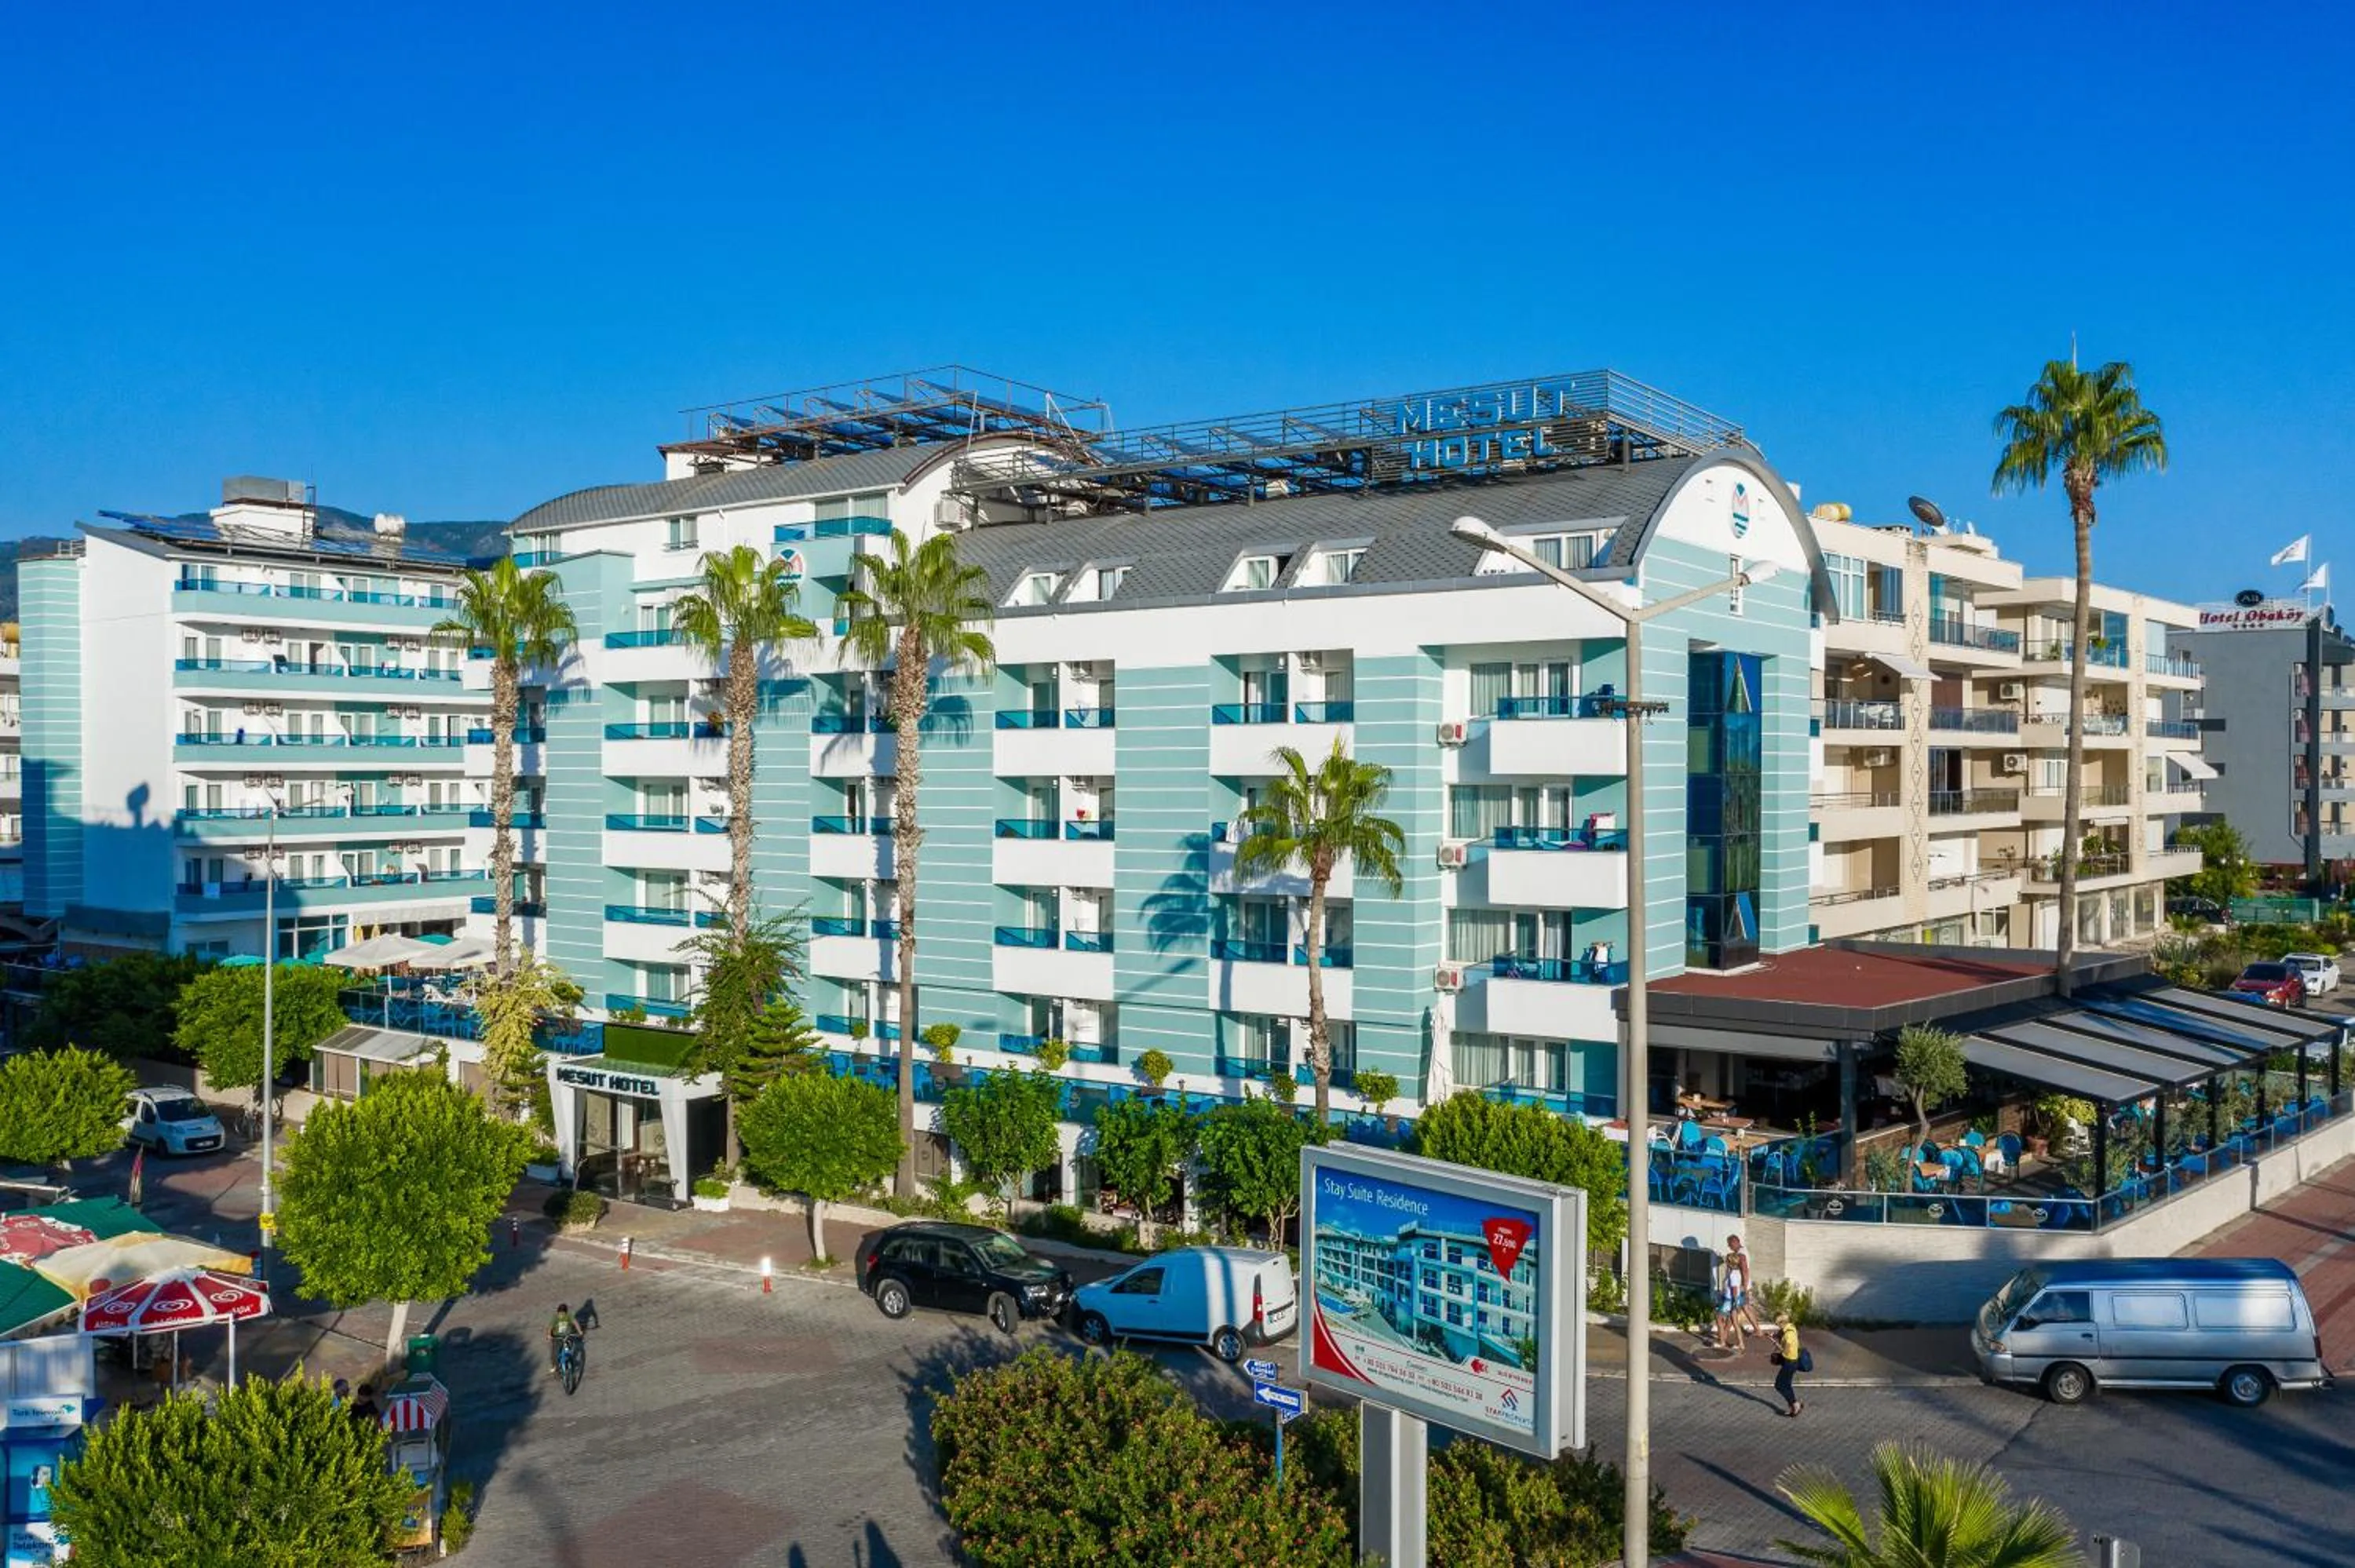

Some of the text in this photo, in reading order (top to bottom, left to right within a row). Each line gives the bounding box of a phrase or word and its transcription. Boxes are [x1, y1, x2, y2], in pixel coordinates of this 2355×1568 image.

[1396, 381, 1575, 434] MESUT
[1402, 426, 1556, 469] HOTEL
[2200, 611, 2240, 624] Hotel
[557, 1067, 660, 1095] MESUT HOTEL
[1324, 1177, 1429, 1215] Stay Suite Residence
